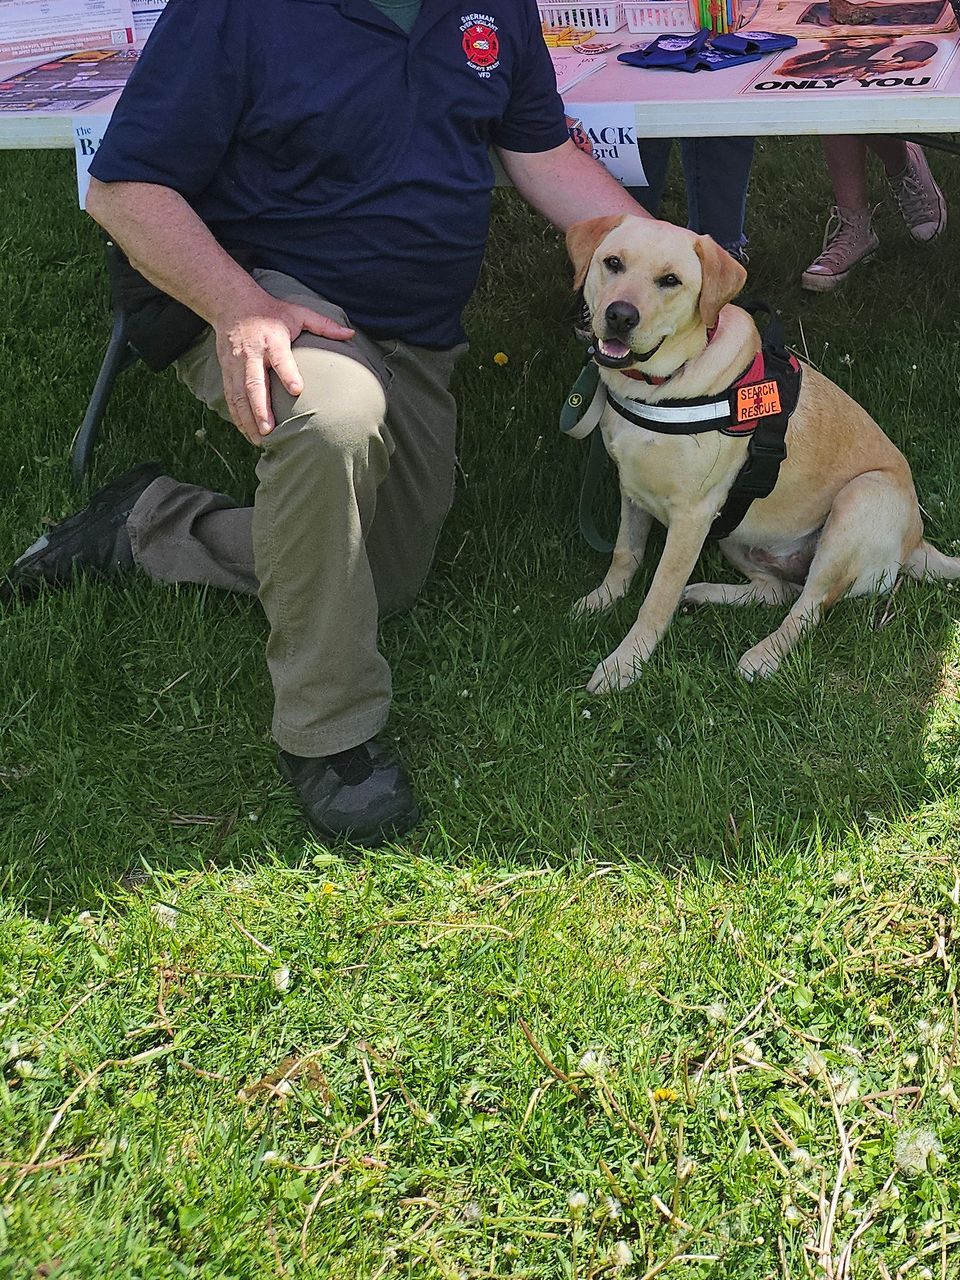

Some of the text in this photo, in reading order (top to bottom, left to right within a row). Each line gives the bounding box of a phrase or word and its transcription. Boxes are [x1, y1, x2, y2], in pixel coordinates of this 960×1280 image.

[459, 19, 499, 32] EVER VIGILANT
[460, 13, 495, 24] SHERMAN
[754, 76, 932, 91] ONLY YOU
[76, 126, 91, 137] The
[80, 137, 103, 156] B
[592, 145, 619, 160] 3rd
[740, 383, 775, 401] SEARCH
[741, 402, 778, 419] RESCUE
